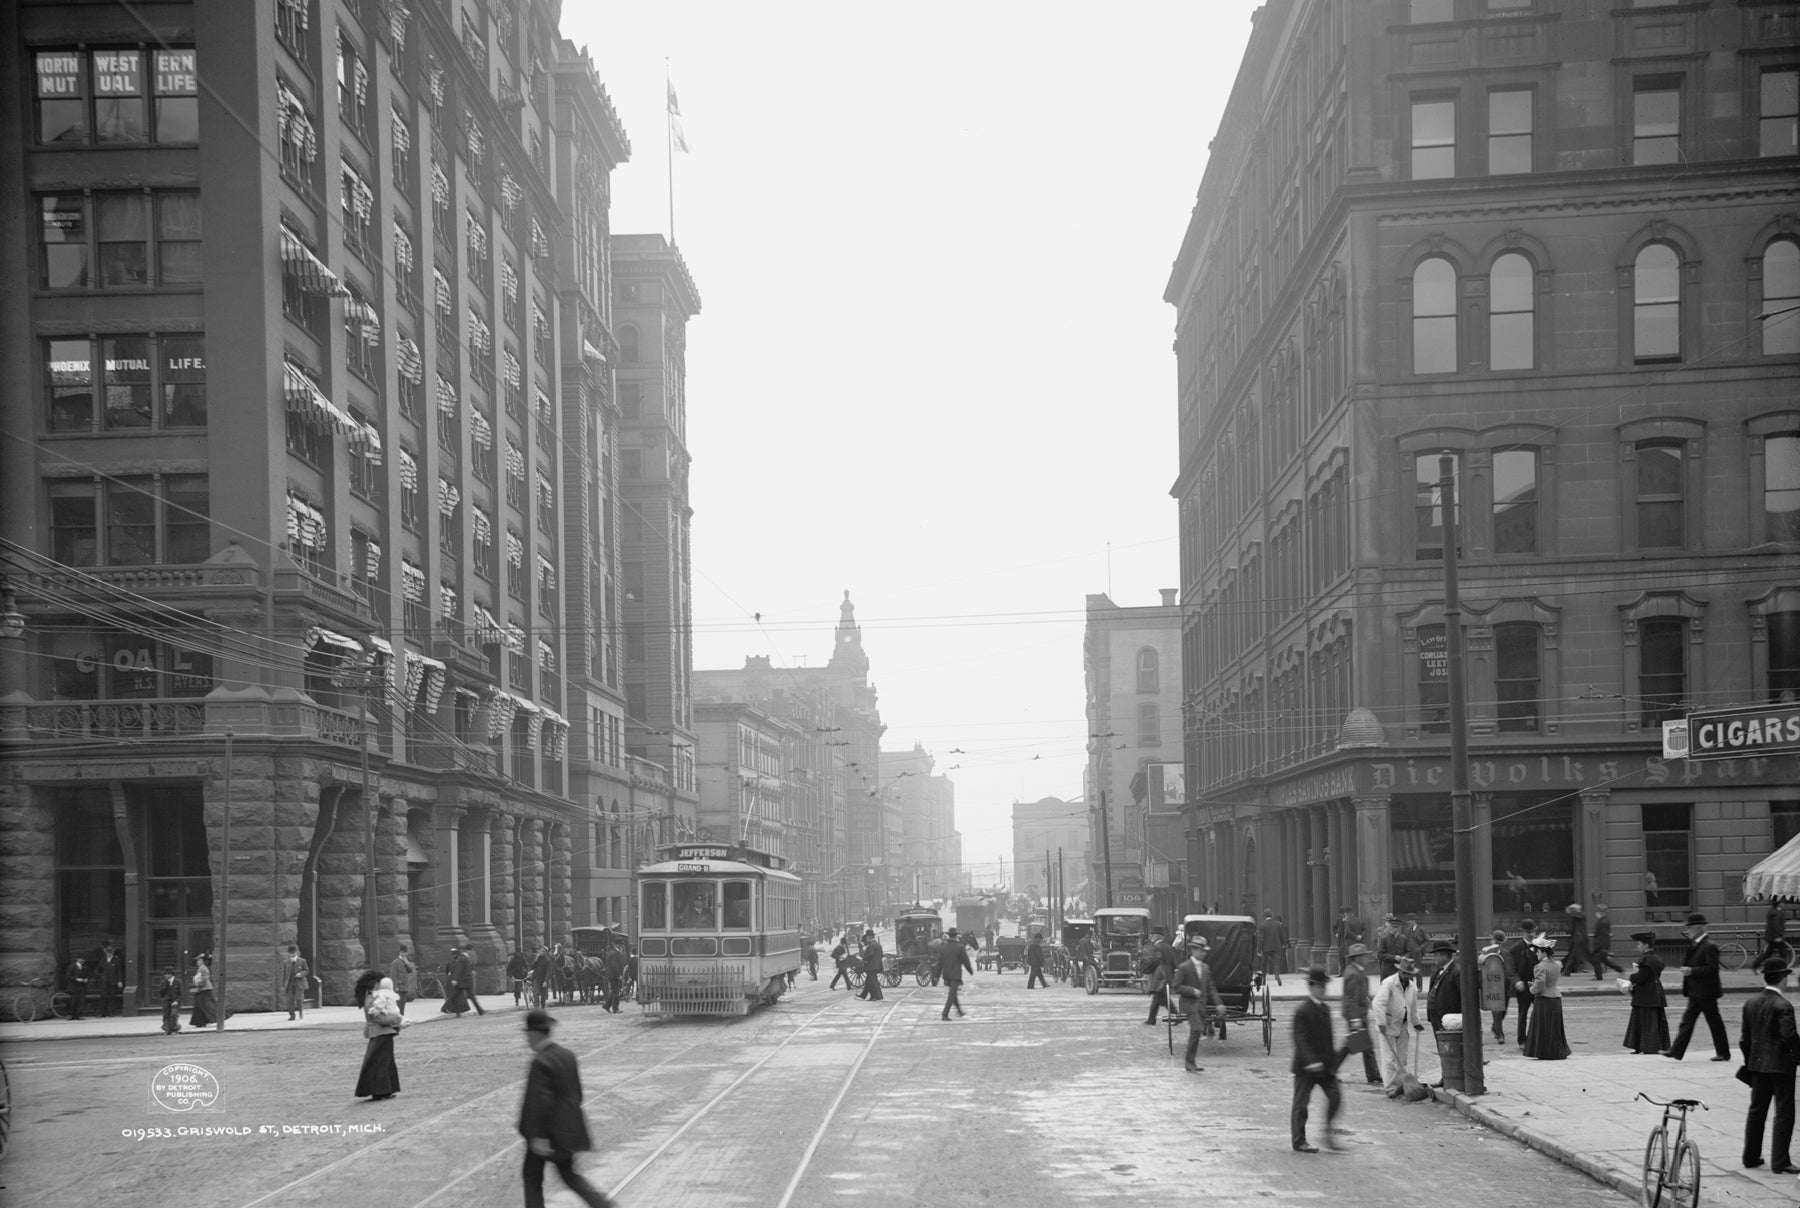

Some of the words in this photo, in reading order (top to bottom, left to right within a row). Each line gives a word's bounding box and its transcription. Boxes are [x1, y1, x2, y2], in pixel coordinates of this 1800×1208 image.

[37, 57, 78, 73] NORTH
[96, 55, 138, 72] WEST
[158, 55, 194, 72] ERN
[42, 76, 76, 92] MUT
[100, 75, 135, 91] UAL
[105, 359, 150, 370] MUTUAL
[169, 357, 206, 369] LIFE.
[1699, 716, 1800, 748] CIGARS
[1370, 759, 1443, 792] Die
[1471, 755, 1619, 788] Volks
[1298, 775, 1329, 803] SAVINGS
[1330, 765, 1355, 796] BANK
[679, 848, 727, 858] JEFFERSON
[1486, 974, 1501, 982] US
